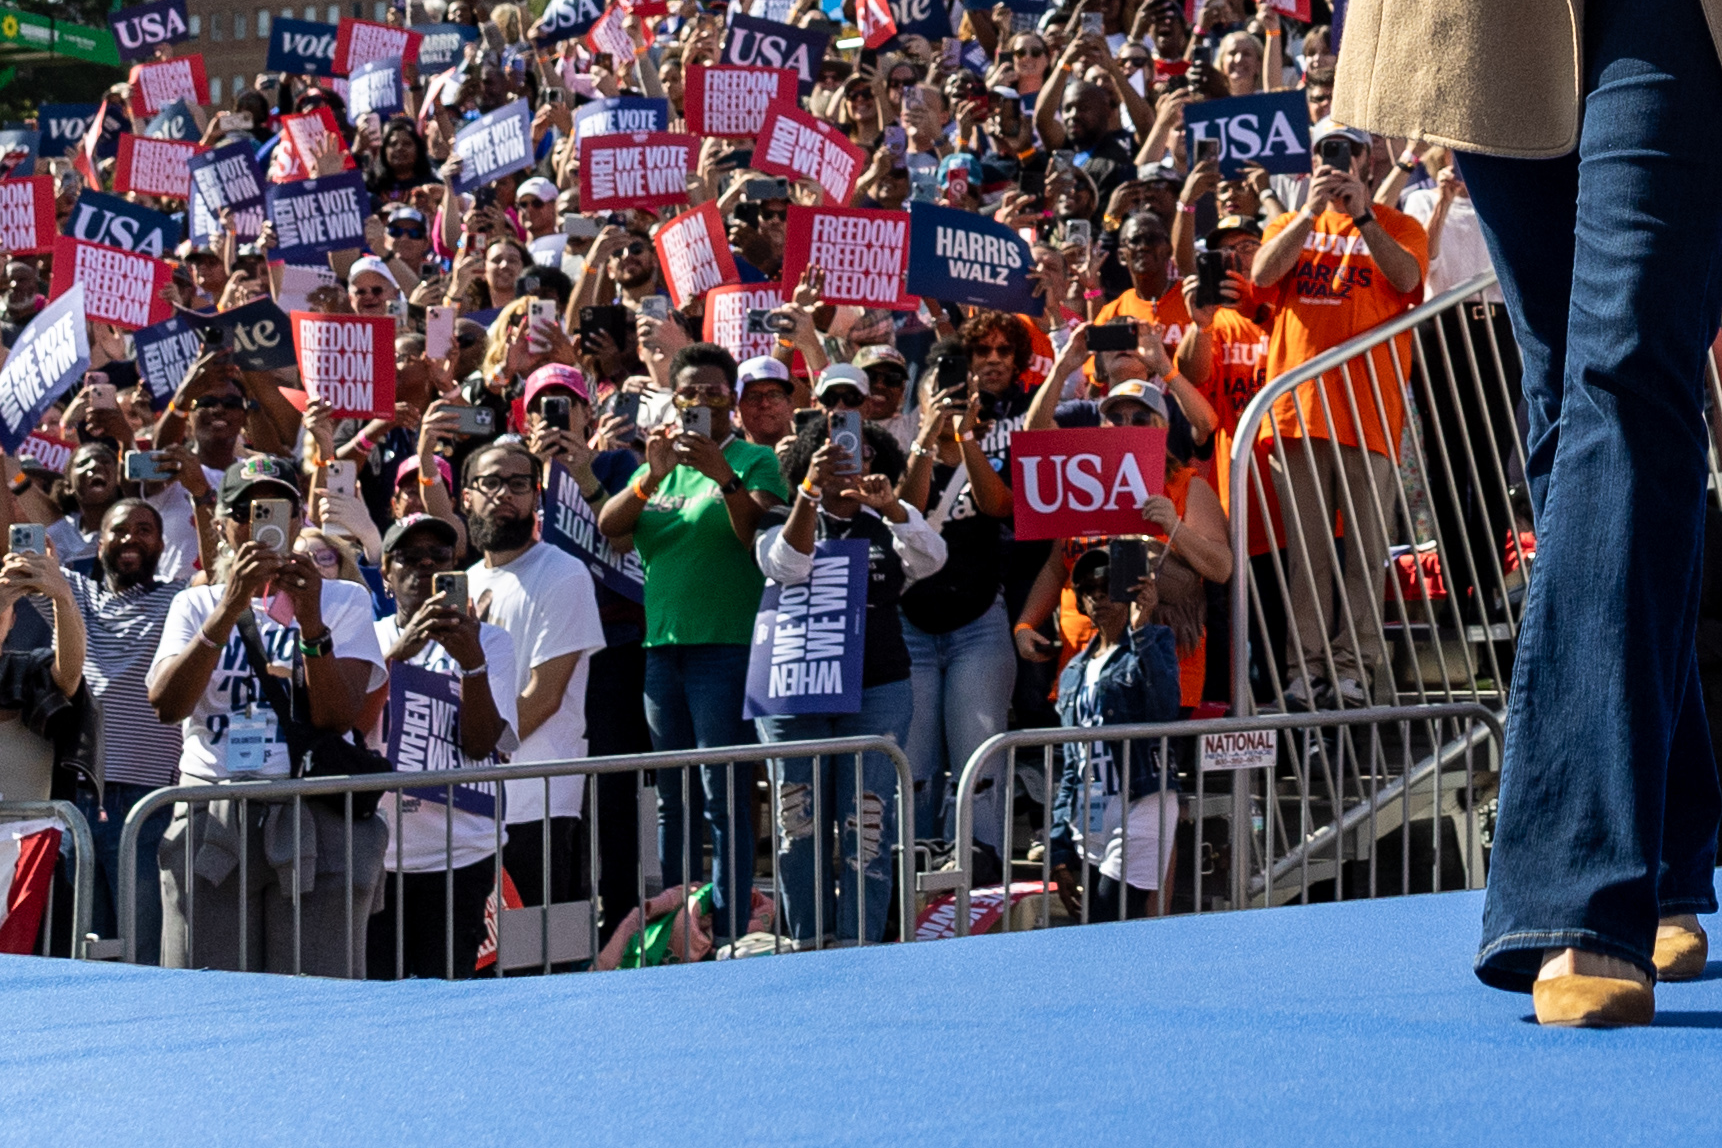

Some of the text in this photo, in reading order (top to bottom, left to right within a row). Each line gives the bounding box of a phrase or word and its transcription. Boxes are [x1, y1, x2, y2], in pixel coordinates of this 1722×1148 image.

[114, 7, 187, 49] USA
[282, 33, 336, 60] vote
[421, 33, 460, 51] ARRIS
[729, 27, 812, 82] USA
[704, 70, 779, 92] FREEDOM
[49, 116, 86, 140] vo
[152, 115, 187, 141] ote
[471, 114, 522, 152] WE VOTE
[617, 109, 657, 130] VOTE
[703, 112, 766, 133] FREEDO
[1188, 110, 1305, 161] USA
[133, 138, 194, 163] FREEDOM
[474, 150, 496, 175] WE
[495, 138, 526, 169] WIN
[766, 114, 800, 165] WHEN
[798, 125, 856, 181] WE VOTE
[592, 149, 615, 200] WHEN
[615, 146, 689, 171] WE VOTE
[791, 145, 850, 203] WE WIN
[615, 167, 687, 197] WE WIN
[292, 186, 358, 219] WE VOTE
[74, 202, 164, 258] USA
[273, 198, 299, 250] WHEN
[297, 210, 363, 245] WE WIN
[660, 212, 706, 254] FREEDOM
[813, 214, 906, 248] FREEDOM
[75, 243, 155, 282] FREEDOM
[666, 238, 714, 284] FREEDOM
[810, 242, 903, 274] FREEDOM
[936, 226, 1022, 268] HARRIS
[74, 266, 153, 303] FREEDOM
[822, 272, 898, 302] REEDOM
[948, 259, 1009, 286] WALZ
[1297, 261, 1373, 287] ARRIS
[84, 289, 149, 327] REEDOM
[10, 311, 74, 377] WE VOTE
[159, 330, 201, 365] WE VO
[233, 319, 281, 352] te
[300, 319, 373, 352] FREEDOM
[14, 332, 78, 413] WE WIN
[143, 342, 170, 398] WHEN
[164, 362, 188, 390] WE
[301, 351, 374, 382] FREEDOM
[1017, 452, 1150, 513] USA
[771, 584, 810, 664] WE VO
[806, 556, 850, 660] WE WIN
[768, 660, 842, 698] WHEN
[397, 691, 431, 772] WHEN
[1205, 732, 1273, 753] NATIONAL
